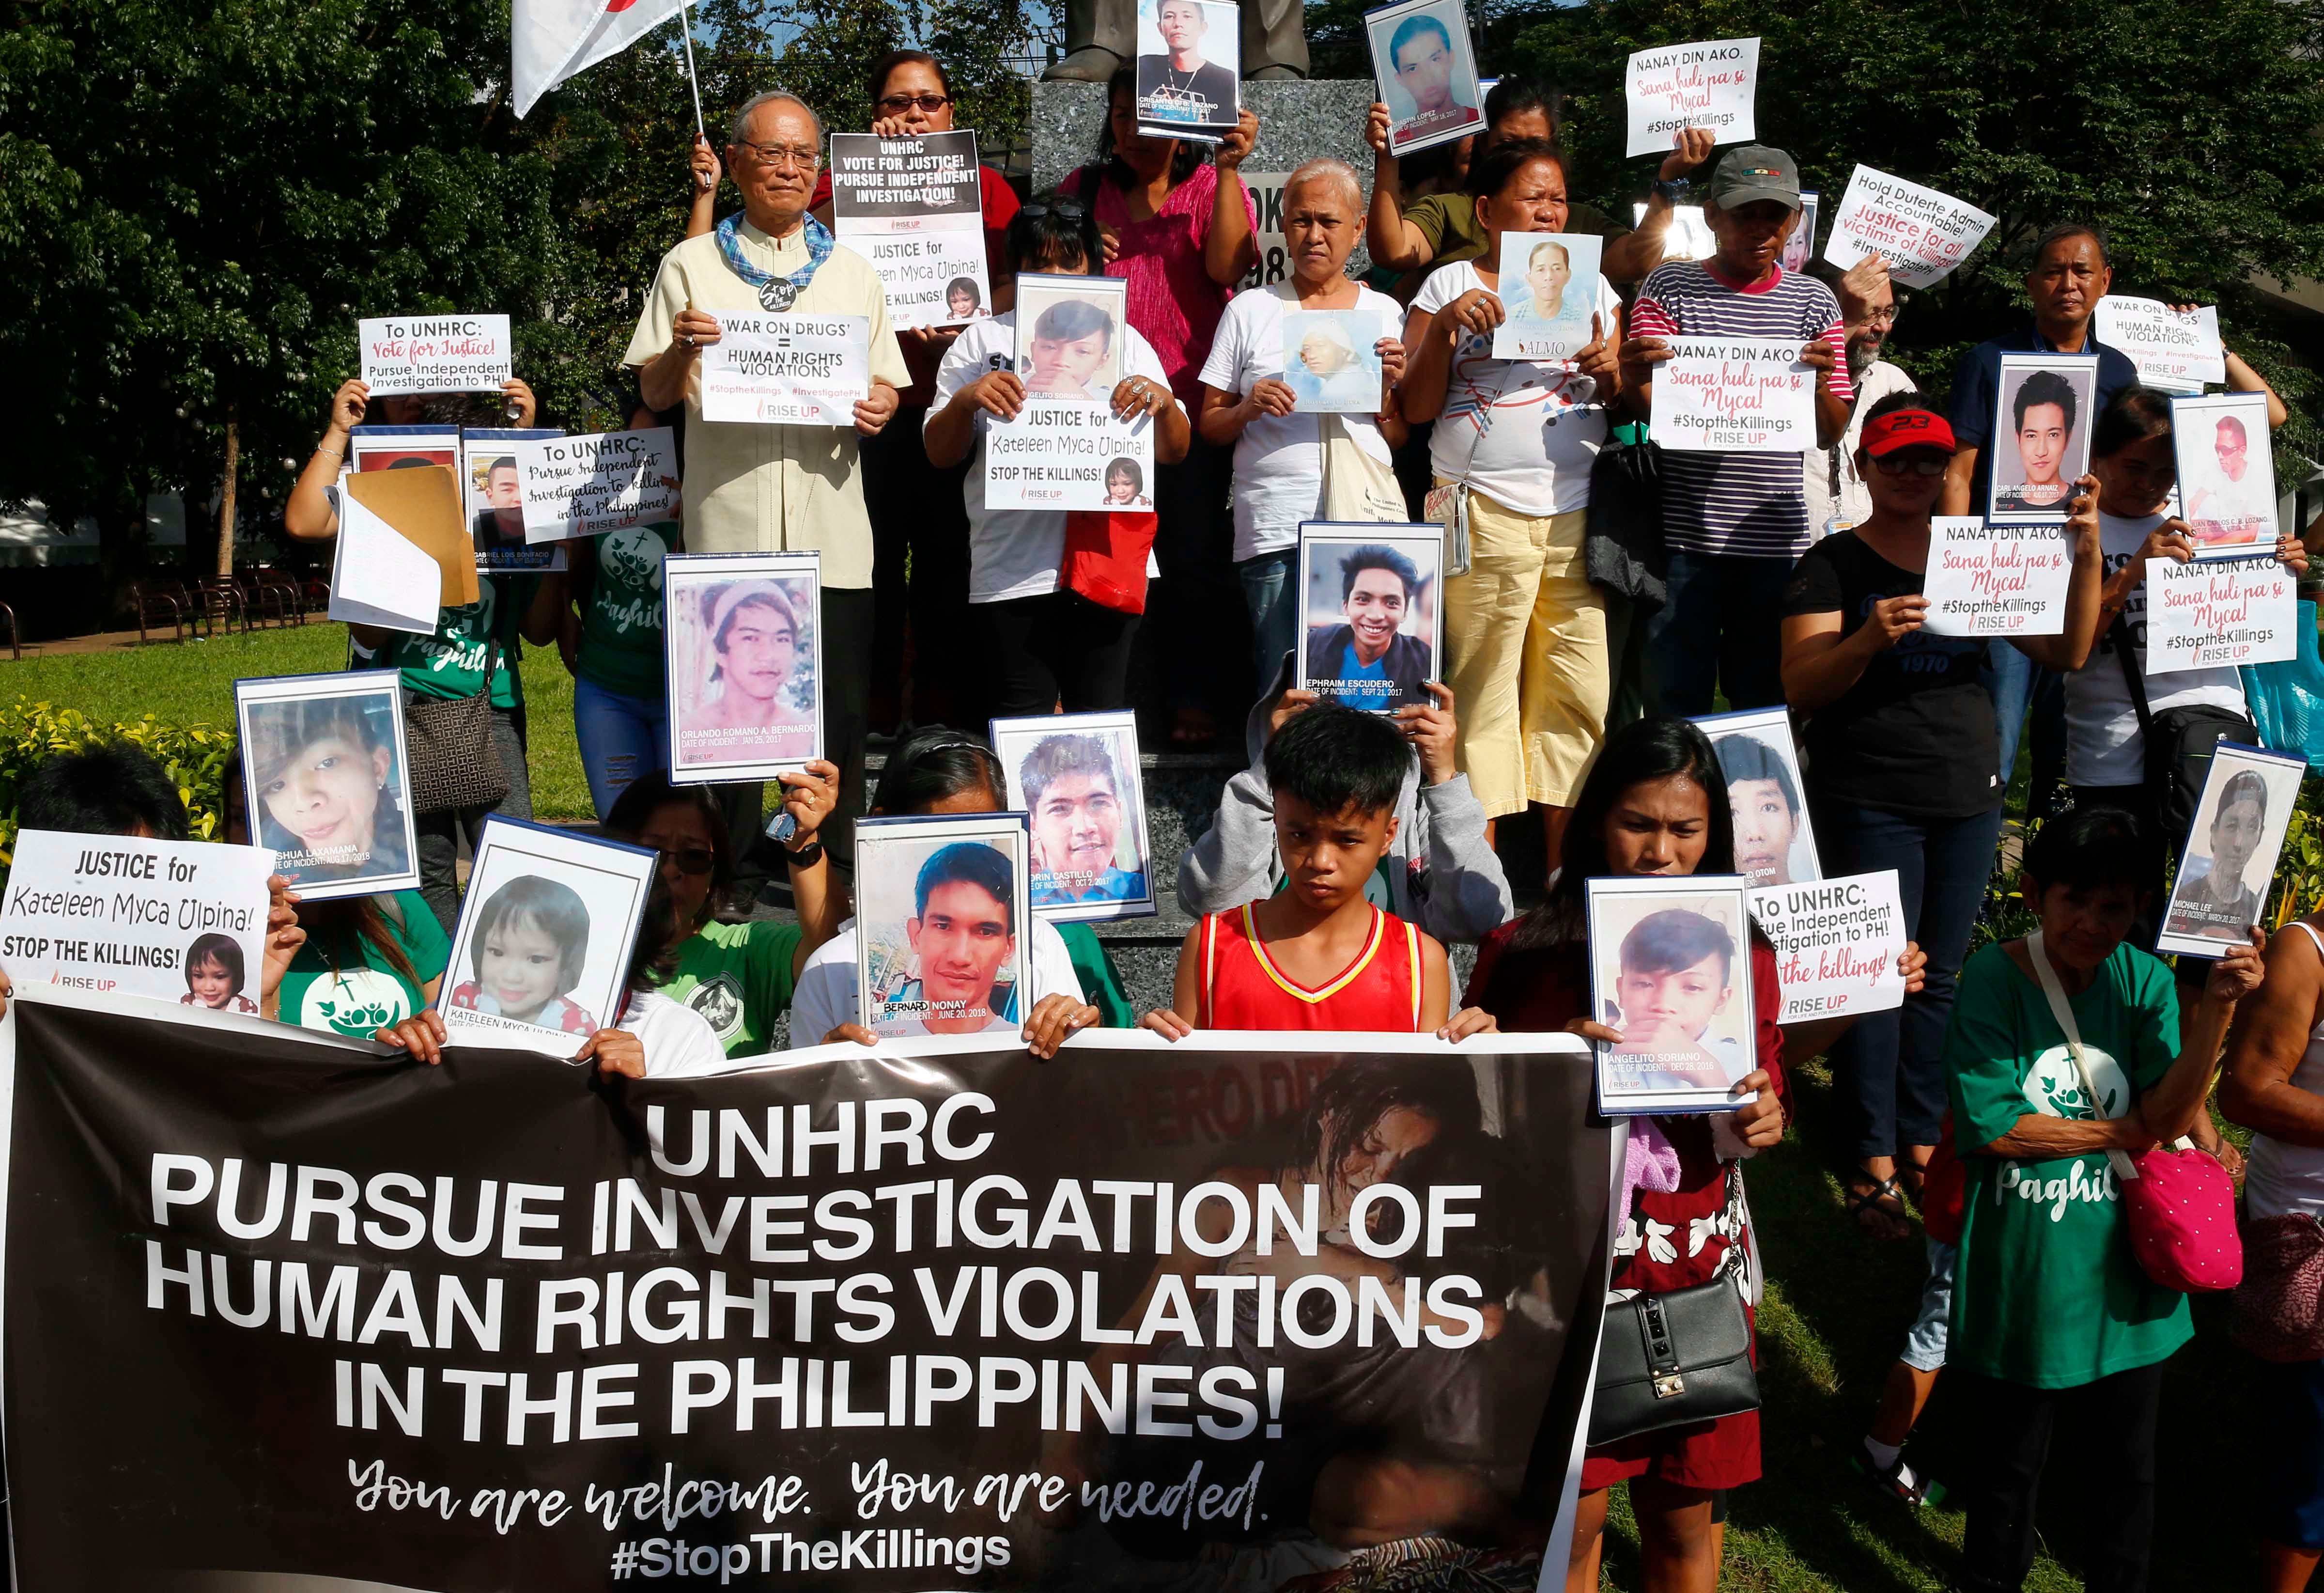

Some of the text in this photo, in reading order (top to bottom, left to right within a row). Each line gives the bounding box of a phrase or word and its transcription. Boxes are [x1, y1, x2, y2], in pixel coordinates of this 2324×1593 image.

[1637, 50, 1704, 72] NANAY DIN
[1139, 96, 1173, 105] CRISANTO
[1417, 110, 1436, 121] LOPEZ
[880, 141, 924, 155] UNHRC
[843, 155, 964, 171] VOTE FOR JUSTICE!
[835, 170, 976, 187] PURSUE INDEPENDENT
[856, 187, 956, 203] INVESTIGATION!
[1858, 175, 1984, 234] Hold Duterte Admin
[1855, 204, 1920, 237] Justice
[1875, 195, 1966, 238] Accountable!
[1844, 219, 1896, 244] victims
[873, 241, 942, 259] JUSTICE for
[895, 291, 943, 305] KILLINGS!
[2143, 305, 2161, 314] ON
[386, 321, 482, 338] To UNHRC:
[766, 322, 790, 334] ON
[2117, 321, 2161, 333] HUMAN
[2125, 330, 2194, 346] VIOLATIONS
[372, 338, 495, 358] Vote Justice!
[1732, 347, 1756, 360] DIN
[728, 350, 843, 366] HUMAN RIGHTS
[369, 362, 509, 377] Pursue Independent
[740, 363, 831, 377] VIOLATIONS
[1670, 365, 1719, 387] Sana
[372, 375, 479, 389] Investigation to
[710, 385, 781, 395] #StoptheKillings
[1701, 387, 1763, 421] Myca!
[1028, 410, 1107, 427] JUSTICE for
[1673, 415, 1792, 432] #StoptheKillings
[1891, 415, 1930, 431] 23
[543, 446, 565, 461] To
[992, 435, 1093, 455] Kateleen Myca
[528, 453, 662, 481] Pursue Independent
[991, 467, 1101, 481] STOP THE KILLINGS!
[528, 482, 609, 505] Investigation
[558, 510, 572, 520] in
[1942, 549, 1988, 569] Sana
[2163, 563, 2212, 580] NANAY
[1971, 569, 2028, 604] Myca!
[1942, 598, 2045, 615] #StoptheKillings
[2164, 589, 2207, 608] Sana
[2193, 599, 2247, 637] Myca!
[2166, 629, 2273, 649] #StoptheKillings
[2233, 646, 2249, 658] UP
[1902, 655, 1948, 672] 1970
[1307, 679, 1394, 688] EPHRAIM ESCUDERO
[682, 723, 816, 739] ORLANDO BERNARDO
[682, 734, 782, 749] DATE OF INCIDENT: JAN 2017
[306, 844, 357, 857] LAXAMANA
[75, 850, 197, 883] JUSTICE for
[284, 852, 370, 868] OF INCIDENT: AUG 2018
[1053, 870, 1093, 880] CASTILLO
[1755, 867, 1776, 877] OTOM
[1044, 880, 1072, 889] INCIDENT:
[1075, 878, 1086, 887] OCT
[1095, 877, 1110, 886] 2017
[10, 885, 254, 932] Kateleen Myca Ulpina!
[1754, 884, 1866, 918] To UNHRC:
[2174, 900, 2212, 912] MICHAEL LEE
[1792, 902, 1891, 931] Independent
[1846, 926, 1860, 942] to
[3, 936, 180, 969] STOP THE KILLINGS!
[1818, 946, 1888, 987] killings!
[62, 976, 94, 988] RISE
[884, 1000, 967, 1012] BERNARD NONAY
[451, 1009, 499, 1028] KATELEEN
[872, 1008, 986, 1023] DATE OF INCIDENT: JUNE 2018
[1608, 1052, 1700, 1063] ANGELITO SORIANO
[1609, 1061, 1713, 1073] DATE OF INCIDENT: DEC 2016
[647, 1092, 995, 1178] UNHRC
[1996, 1159, 2120, 1222] Paghil
[152, 1153, 1482, 1263] PURSUE INVESTIGATION OF
[146, 1240, 1485, 1354] HUMAN RIGHTS VIOLATIONS
[335, 1356, 1285, 1446] IN THE PHILIPPINES!
[349, 1457, 1268, 1535] You are welcome. You are needed.
[610, 1527, 1011, 1585] #StopTheKillings
